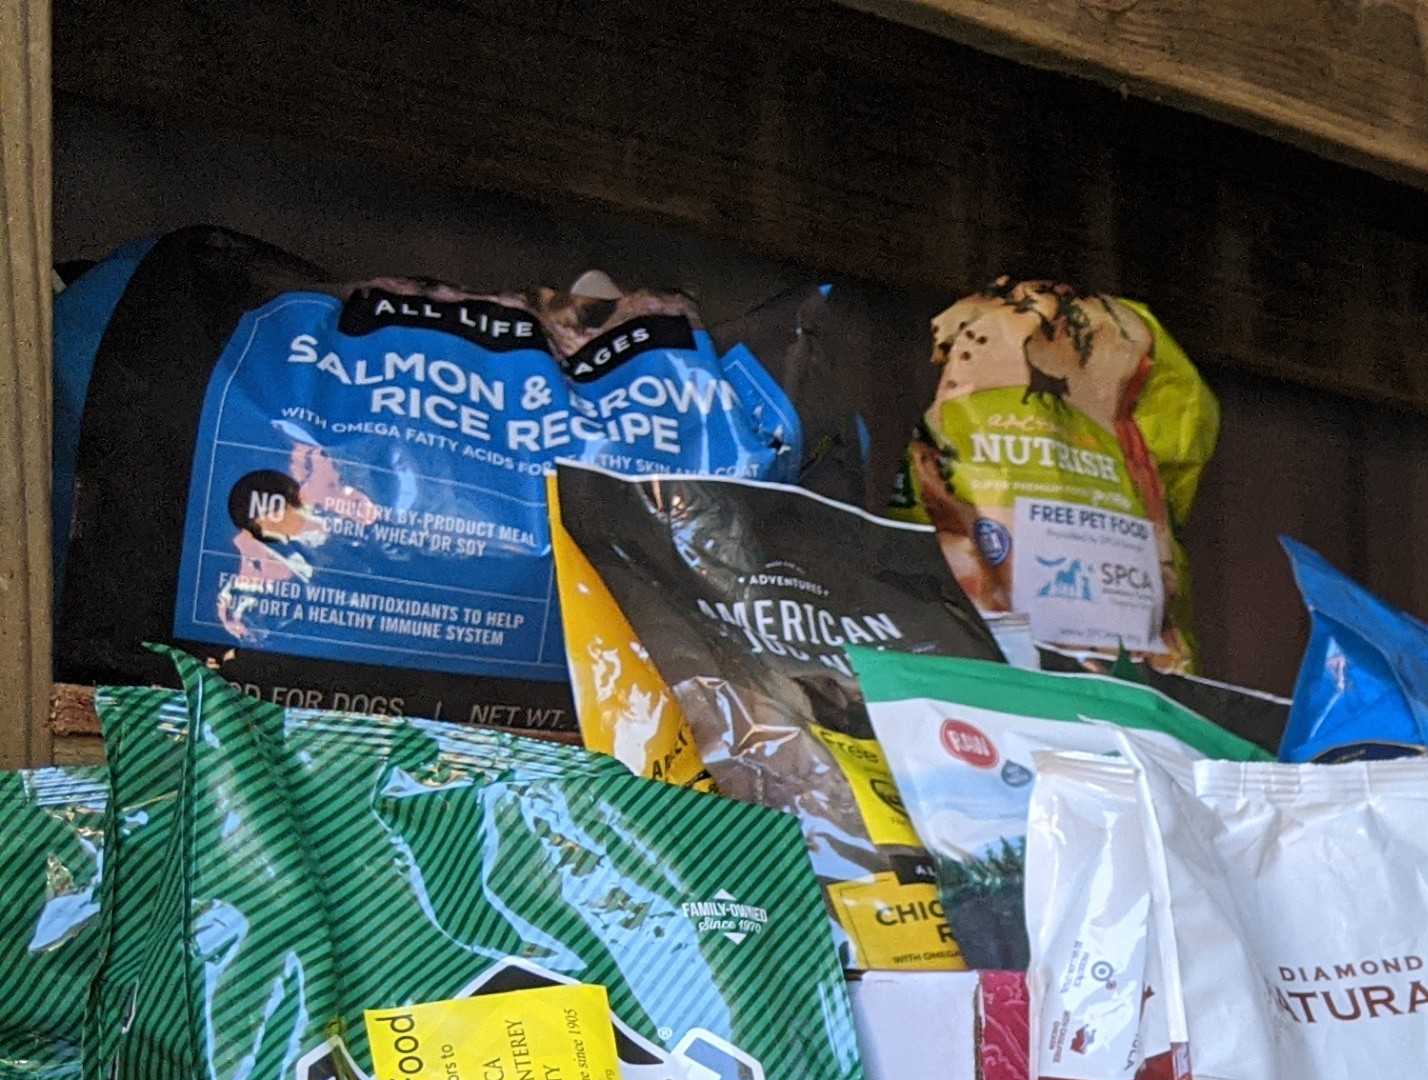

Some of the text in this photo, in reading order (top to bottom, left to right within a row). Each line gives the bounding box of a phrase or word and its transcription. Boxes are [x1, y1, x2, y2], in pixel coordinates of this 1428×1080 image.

[375, 299, 650, 376] ALL LIFE AGES
[287, 334, 505, 411] SALMON
[520, 375, 553, 411] &
[281, 406, 328, 429] WITH
[331, 421, 400, 439] OMEGA
[405, 427, 458, 452] FATTY
[462, 444, 514, 469] ACIDS
[370, 386, 682, 455] RICE RECIPE
[635, 457, 673, 475] SKIN
[971, 432, 1120, 483] NUTRISH
[248, 489, 287, 523] NO
[323, 496, 538, 548] POULTRY BY-PRODUCT MEAL
[1030, 503, 1075, 525] FREE
[1079, 508, 1110, 530] PET
[1111, 515, 1149, 542] FOOD
[373, 524, 430, 548] WHEAT
[430, 533, 452, 553] OR
[456, 536, 488, 557] SOY
[305, 584, 346, 605] WITH
[350, 589, 459, 623] ANTIOXIDANTS
[463, 607, 481, 626] TO
[485, 610, 526, 630] HELP
[292, 602, 305, 620] A
[307, 604, 375, 631] HEALTHY
[379, 615, 441, 641] IMMUNE
[445, 622, 505, 647] SYSTEM
[272, 686, 324, 713] FOR
[333, 690, 406, 719] DOGS
[682, 902, 768, 923] FAMILY-OWNED
[876, 900, 945, 926] CHIC
[1278, 954, 1425, 983] DIAMOND
[564, 1008, 583, 1035] 1905
[441, 1043, 455, 1060] to
[573, 1038, 589, 1068] since
